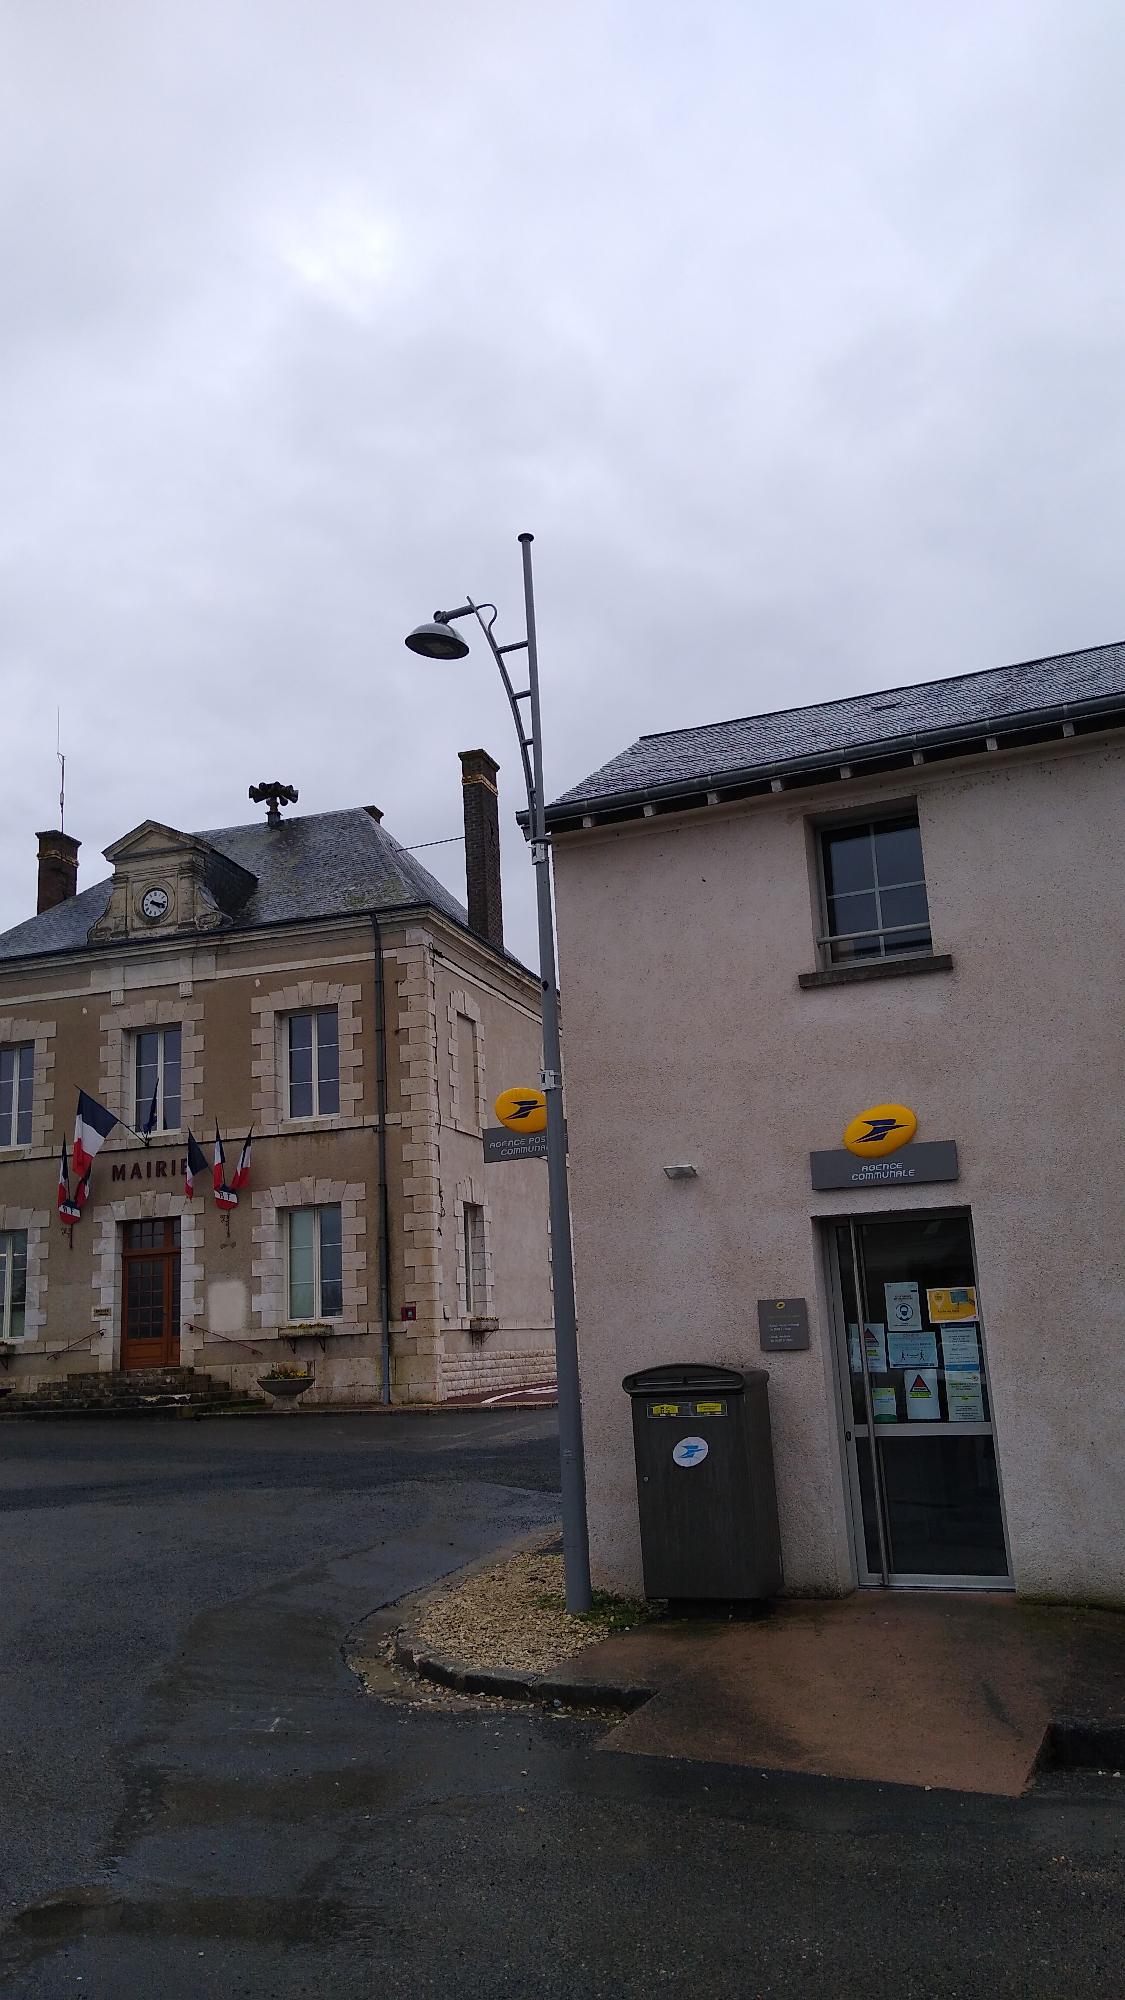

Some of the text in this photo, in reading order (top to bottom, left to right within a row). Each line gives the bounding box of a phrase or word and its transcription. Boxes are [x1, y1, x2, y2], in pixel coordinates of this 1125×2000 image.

[490, 1135, 546, 1149] AGENCE POS
[500, 1145, 548, 1156] COMMUNA
[112, 1158, 187, 1181] MAIRIE
[861, 1162, 904, 1172] AGENCE
[851, 1169, 916, 1181] COMMUNALE
